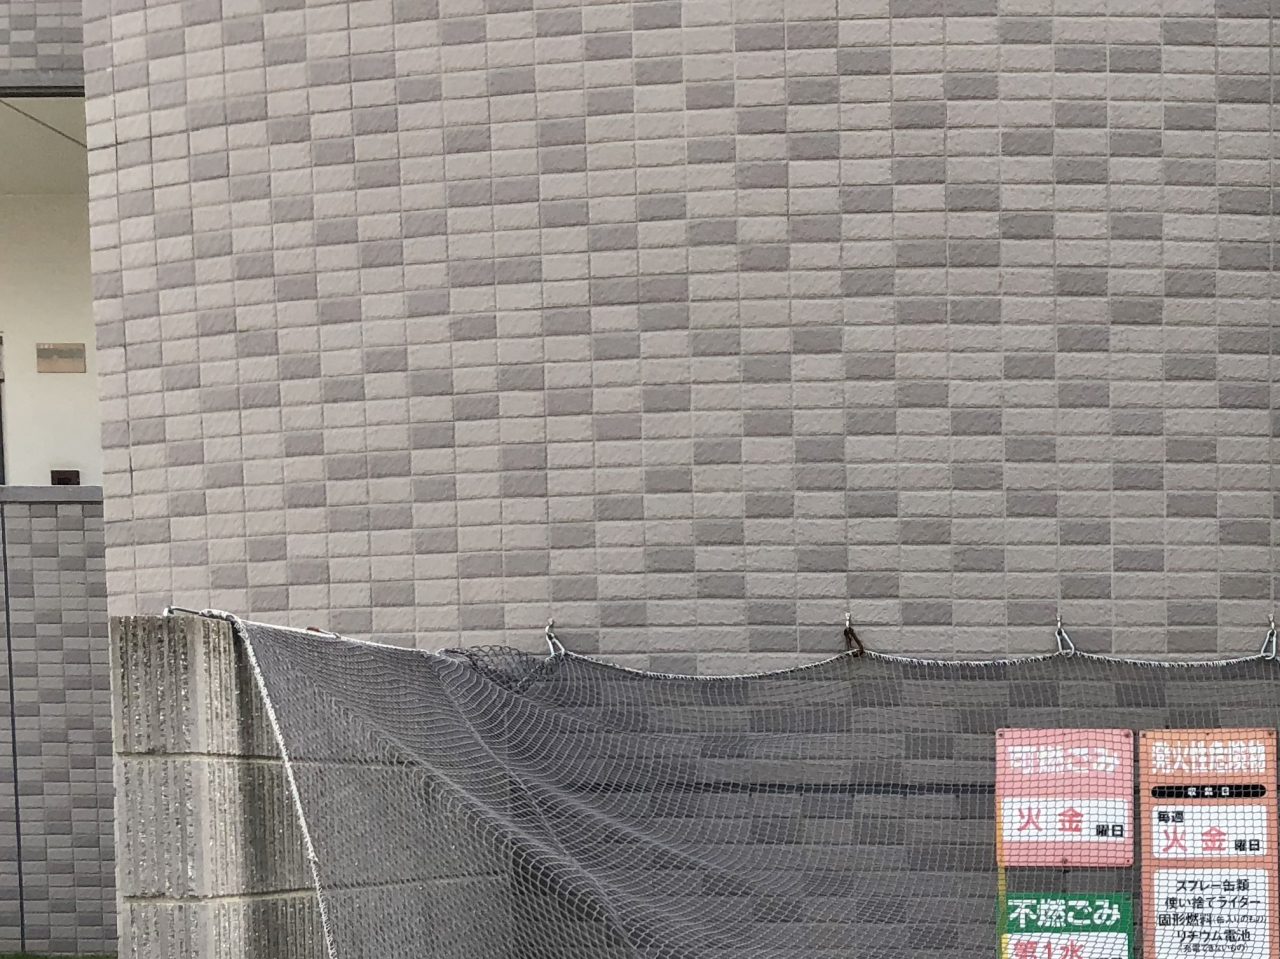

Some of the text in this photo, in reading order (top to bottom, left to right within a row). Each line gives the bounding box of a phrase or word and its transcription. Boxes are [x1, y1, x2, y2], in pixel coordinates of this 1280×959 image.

[1017, 806, 1124, 837] 火 金 曜日
[1162, 826, 1260, 852] 火 金 曜日
[1007, 898, 1121, 928] 不燃ごみ
[1165, 896, 1261, 909] 使い捨てライター
[1176, 929, 1251, 942] リチウム電池
